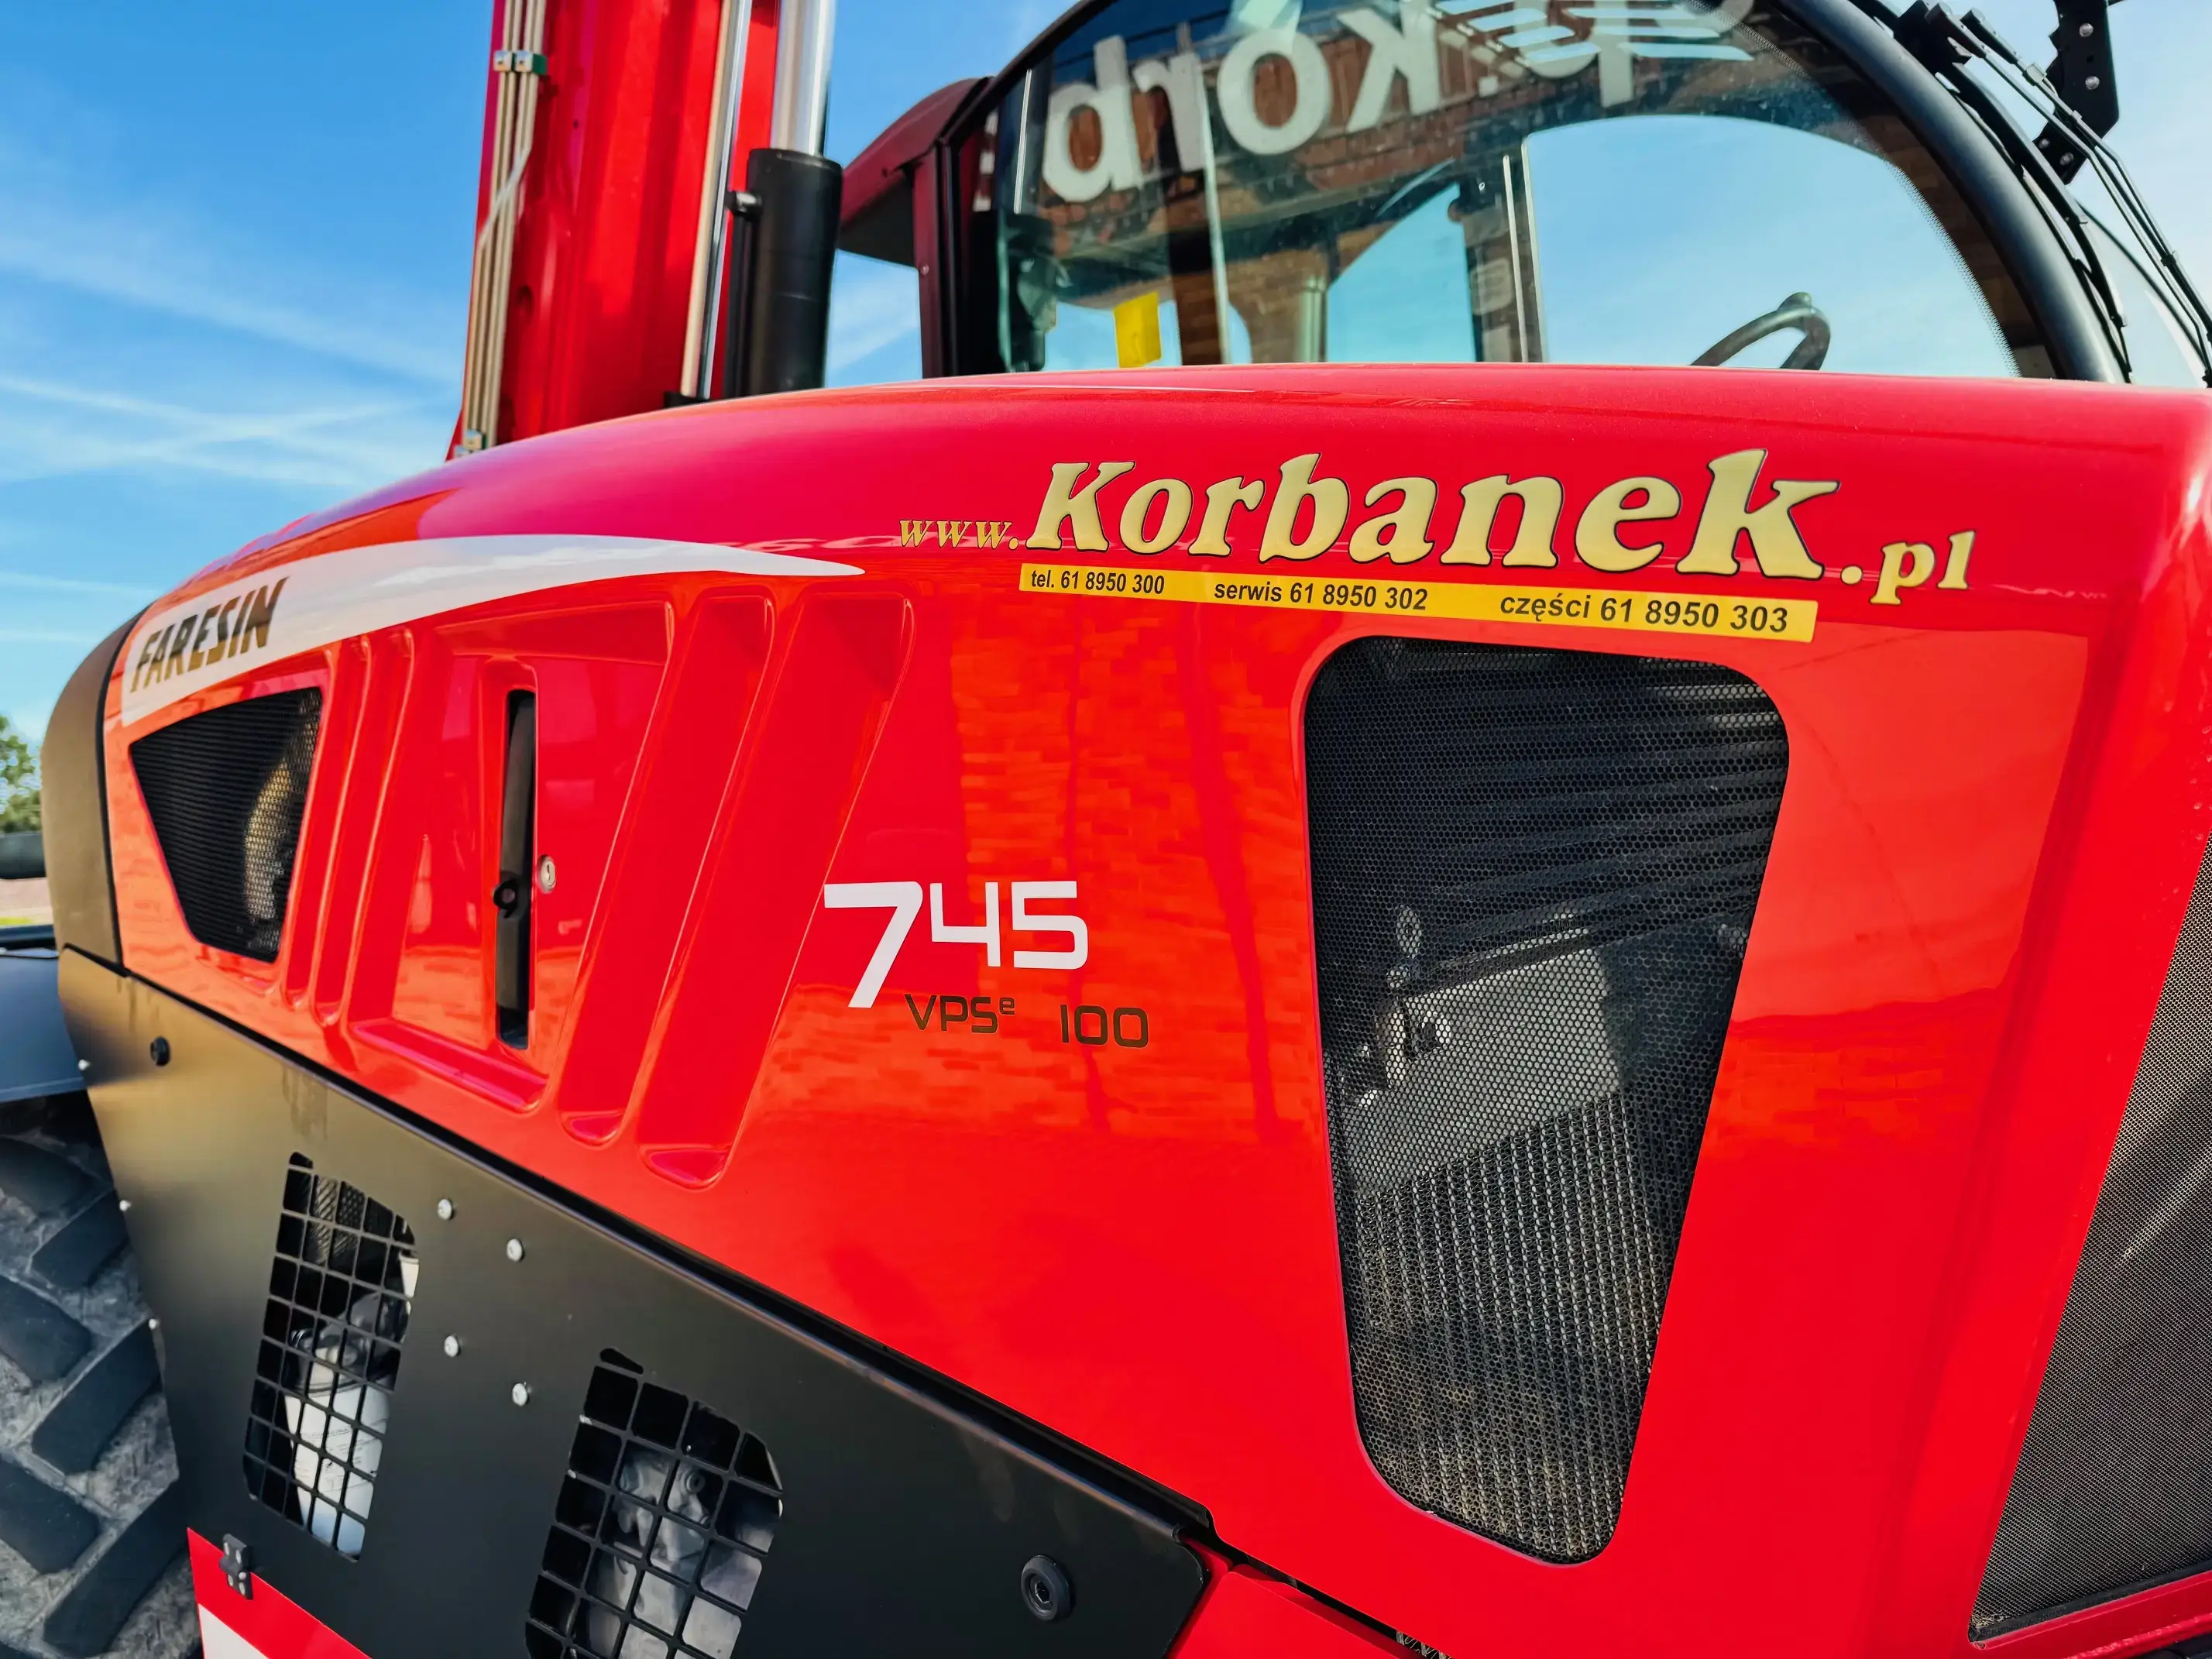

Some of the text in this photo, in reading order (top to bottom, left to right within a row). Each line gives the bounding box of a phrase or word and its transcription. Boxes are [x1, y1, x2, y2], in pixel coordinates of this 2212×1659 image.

[899, 448, 1975, 605] www.Korbanek.pl
[130, 575, 290, 693] FARESIN
[1030, 568, 1789, 634] tel. 61 8950 300 serwis 61 8950 302 części 61 8950 303
[823, 880, 1089, 1010] 745
[1060, 1004, 1149, 1049] 100
